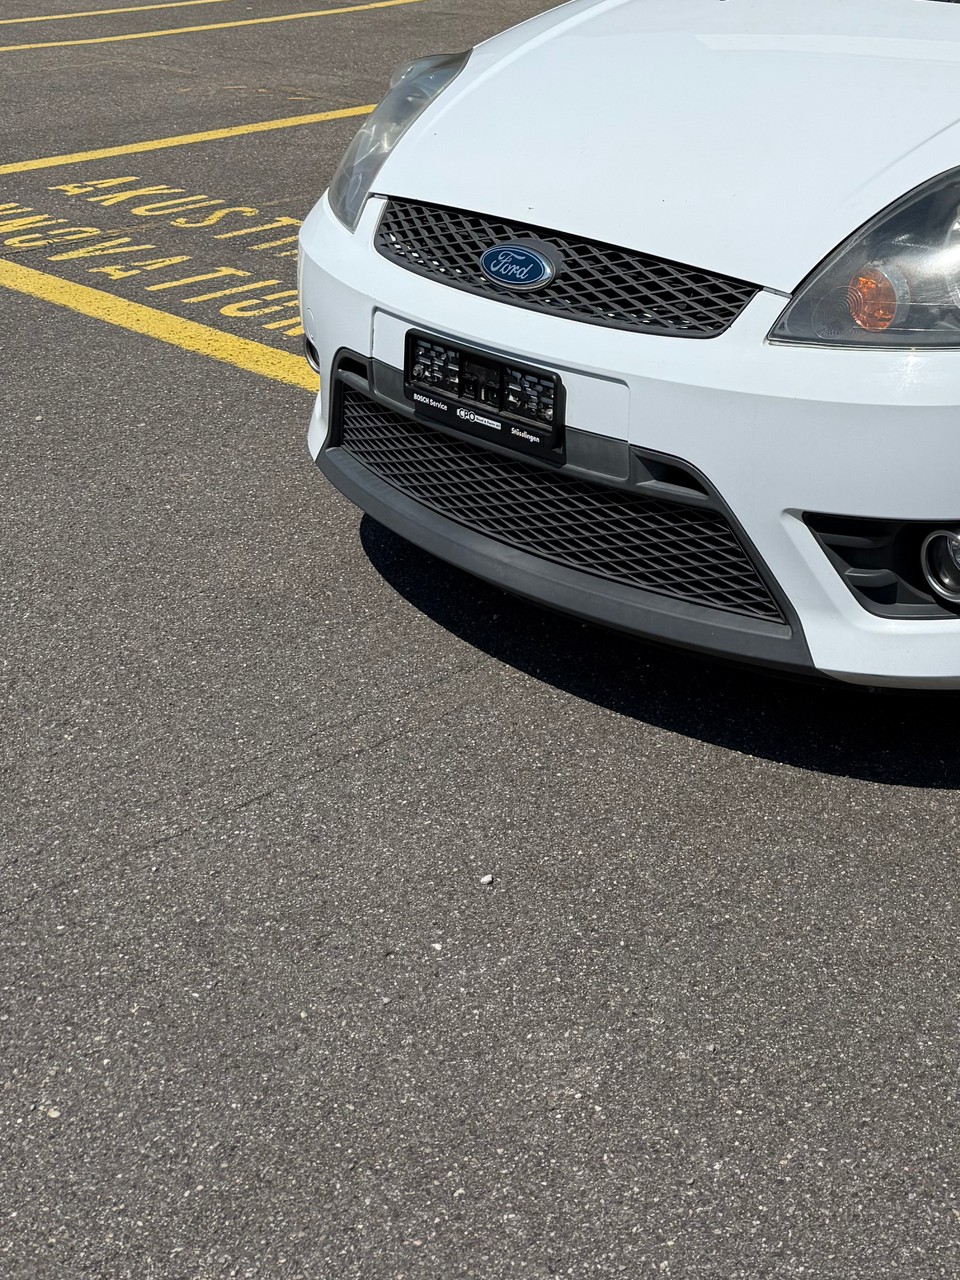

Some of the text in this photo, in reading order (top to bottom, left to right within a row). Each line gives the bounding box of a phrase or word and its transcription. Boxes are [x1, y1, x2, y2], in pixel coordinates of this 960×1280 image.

[48, 175, 303, 260] AKUSTI
[490, 250, 534, 280] Ford
[413, 392, 448, 411] BOSCH Service
